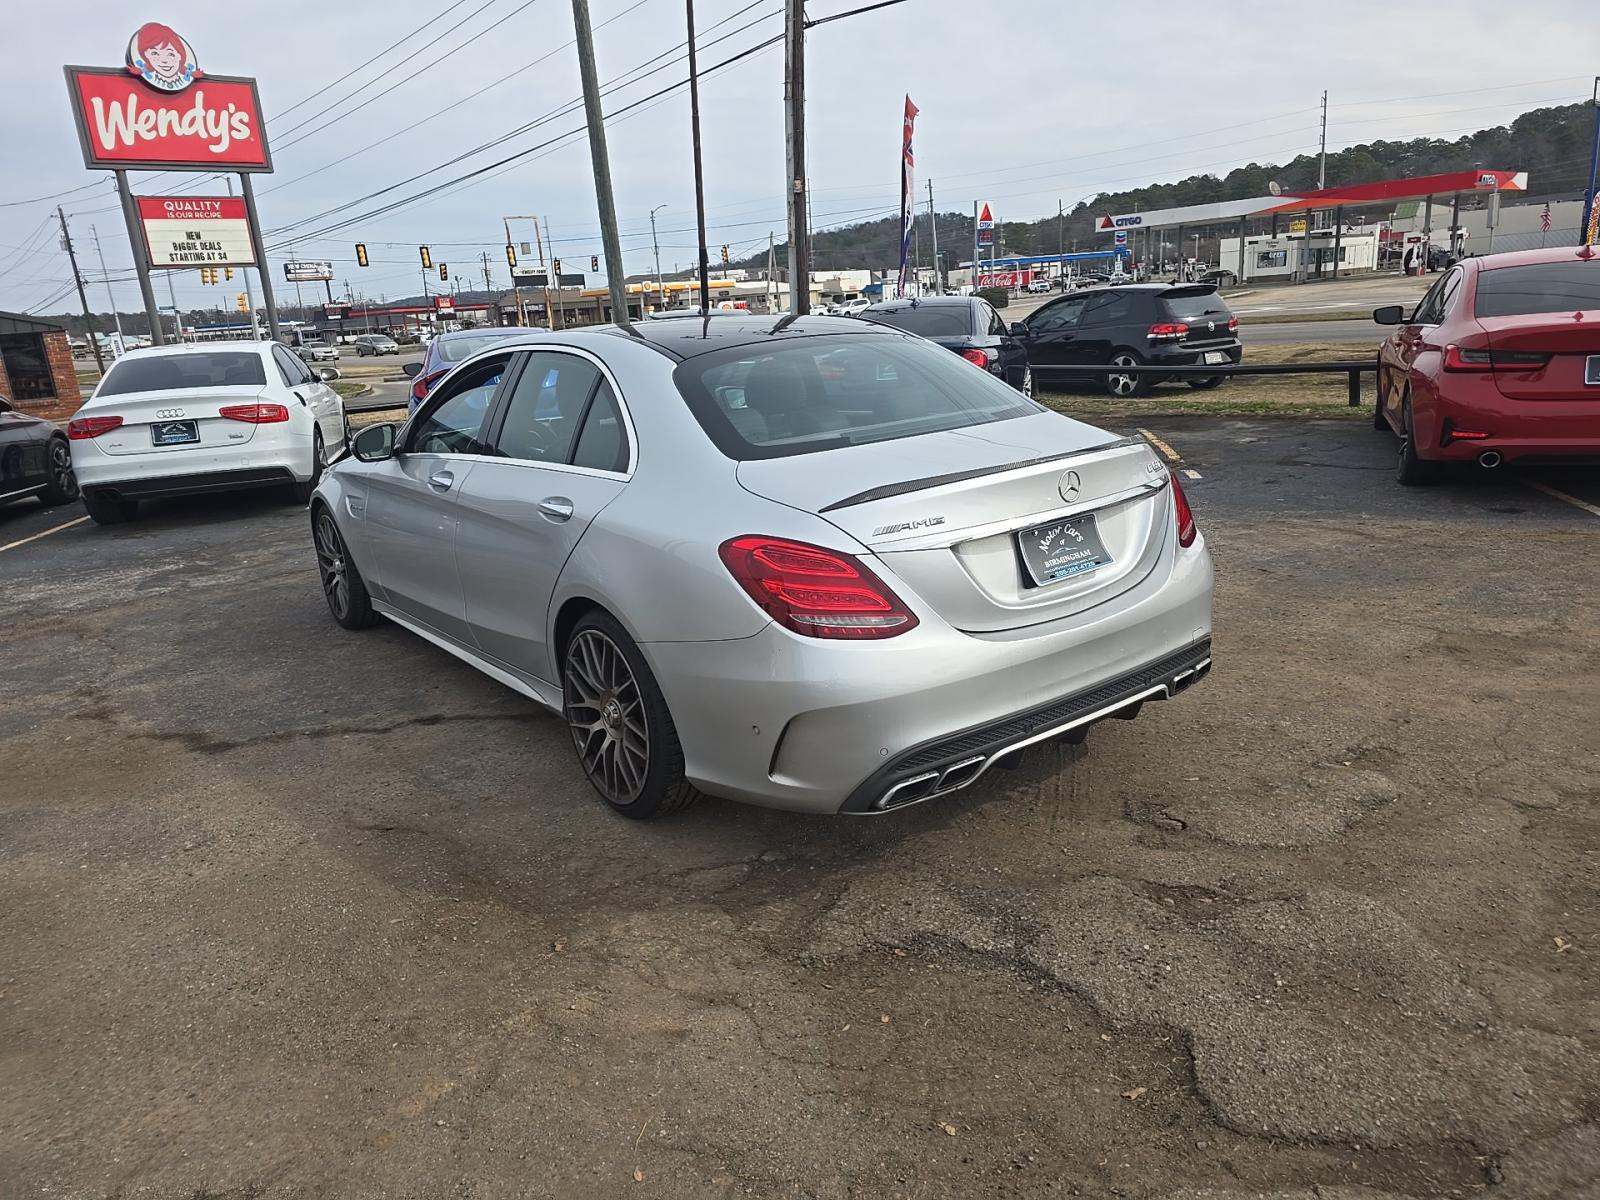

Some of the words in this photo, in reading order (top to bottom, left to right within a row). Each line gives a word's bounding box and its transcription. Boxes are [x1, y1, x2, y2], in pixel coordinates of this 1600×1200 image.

[91, 91, 251, 153] Wendy's
[163, 201, 221, 212] QUALITY
[167, 211, 175, 219] IS
[175, 211, 193, 219] OUR
[194, 211, 222, 219] RECIPE
[1115, 216, 1142, 227] CITGO
[185, 231, 202, 241] NEW
[172, 241, 199, 252] BIGGIE
[199, 241, 222, 251] DEALS
[169, 251, 206, 262] STARTING
[207, 251, 216, 261] AT
[889, 516, 946, 533] AMG
[1038, 525, 1063, 555] Motor
[1063, 523, 1084, 542] Cars
[1043, 548, 1092, 568] BIRMINGHAM
